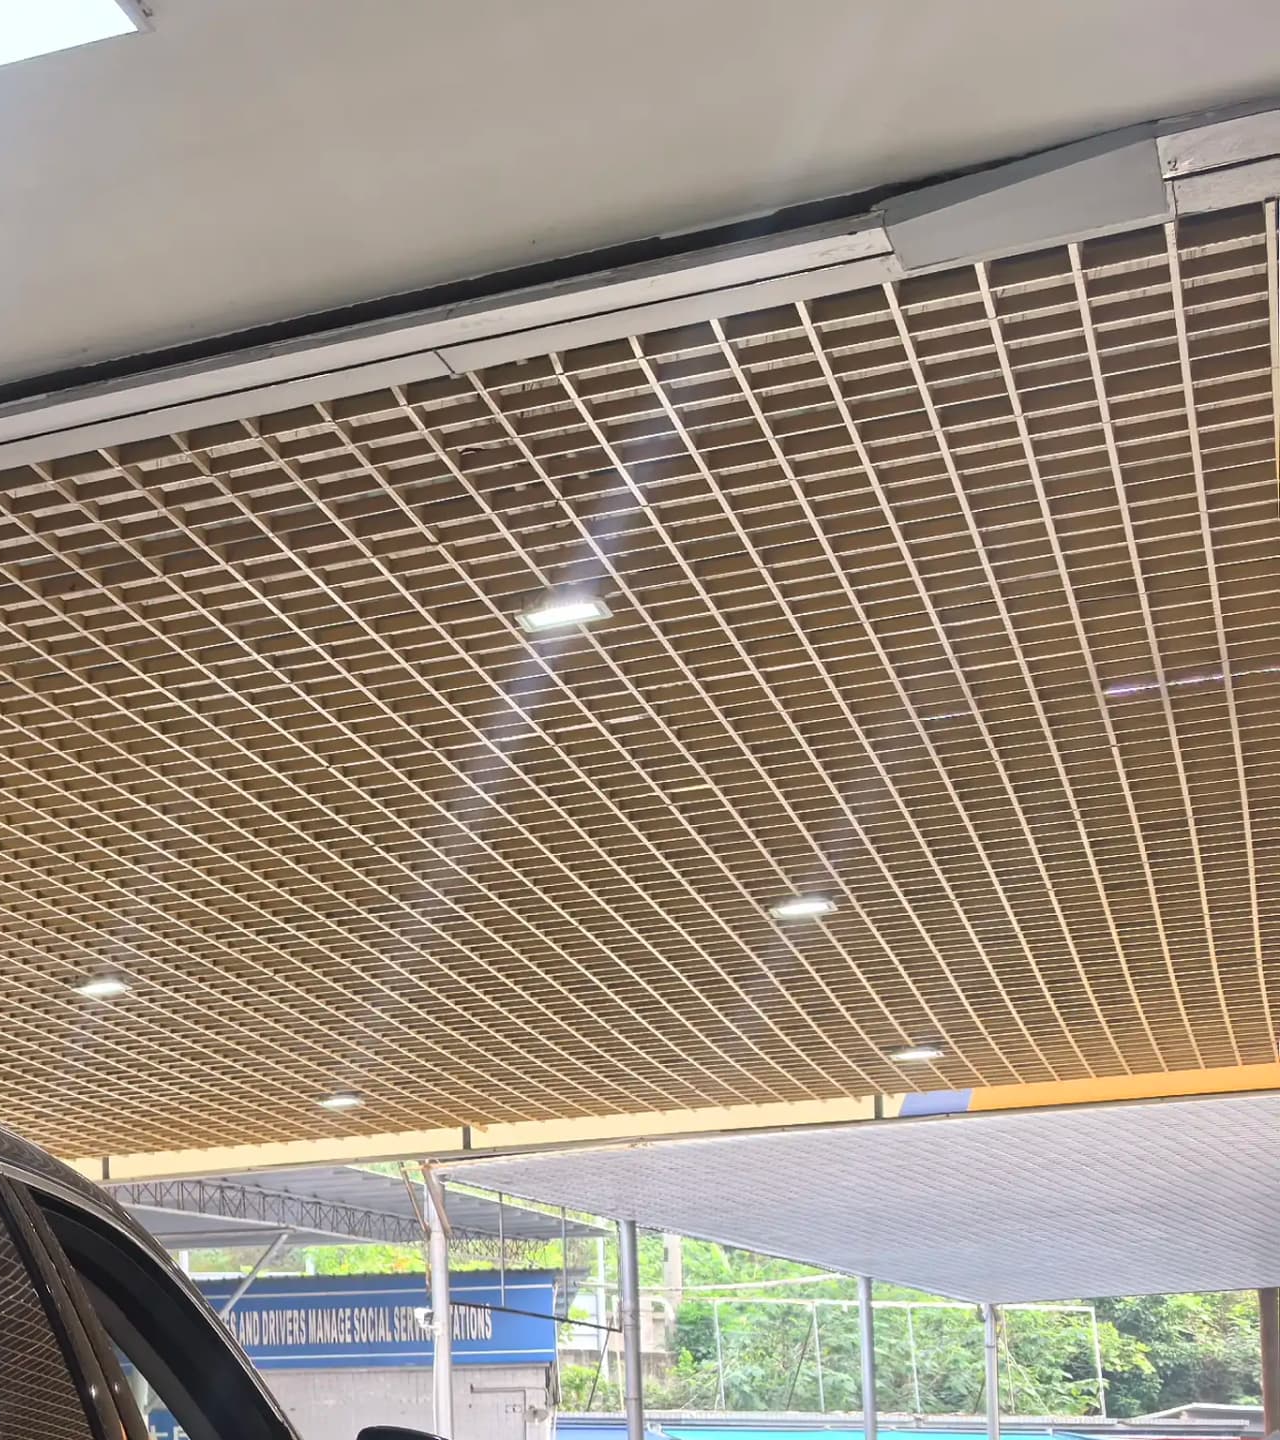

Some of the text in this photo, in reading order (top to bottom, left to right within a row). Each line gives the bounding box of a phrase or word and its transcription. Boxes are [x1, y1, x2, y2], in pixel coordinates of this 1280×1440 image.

[239, 1311, 260, 1345] AND
[262, 1309, 306, 1345] DRIVERS
[308, 1307, 352, 1344] MANAGE
[353, 1307, 392, 1342] SOCIAL
